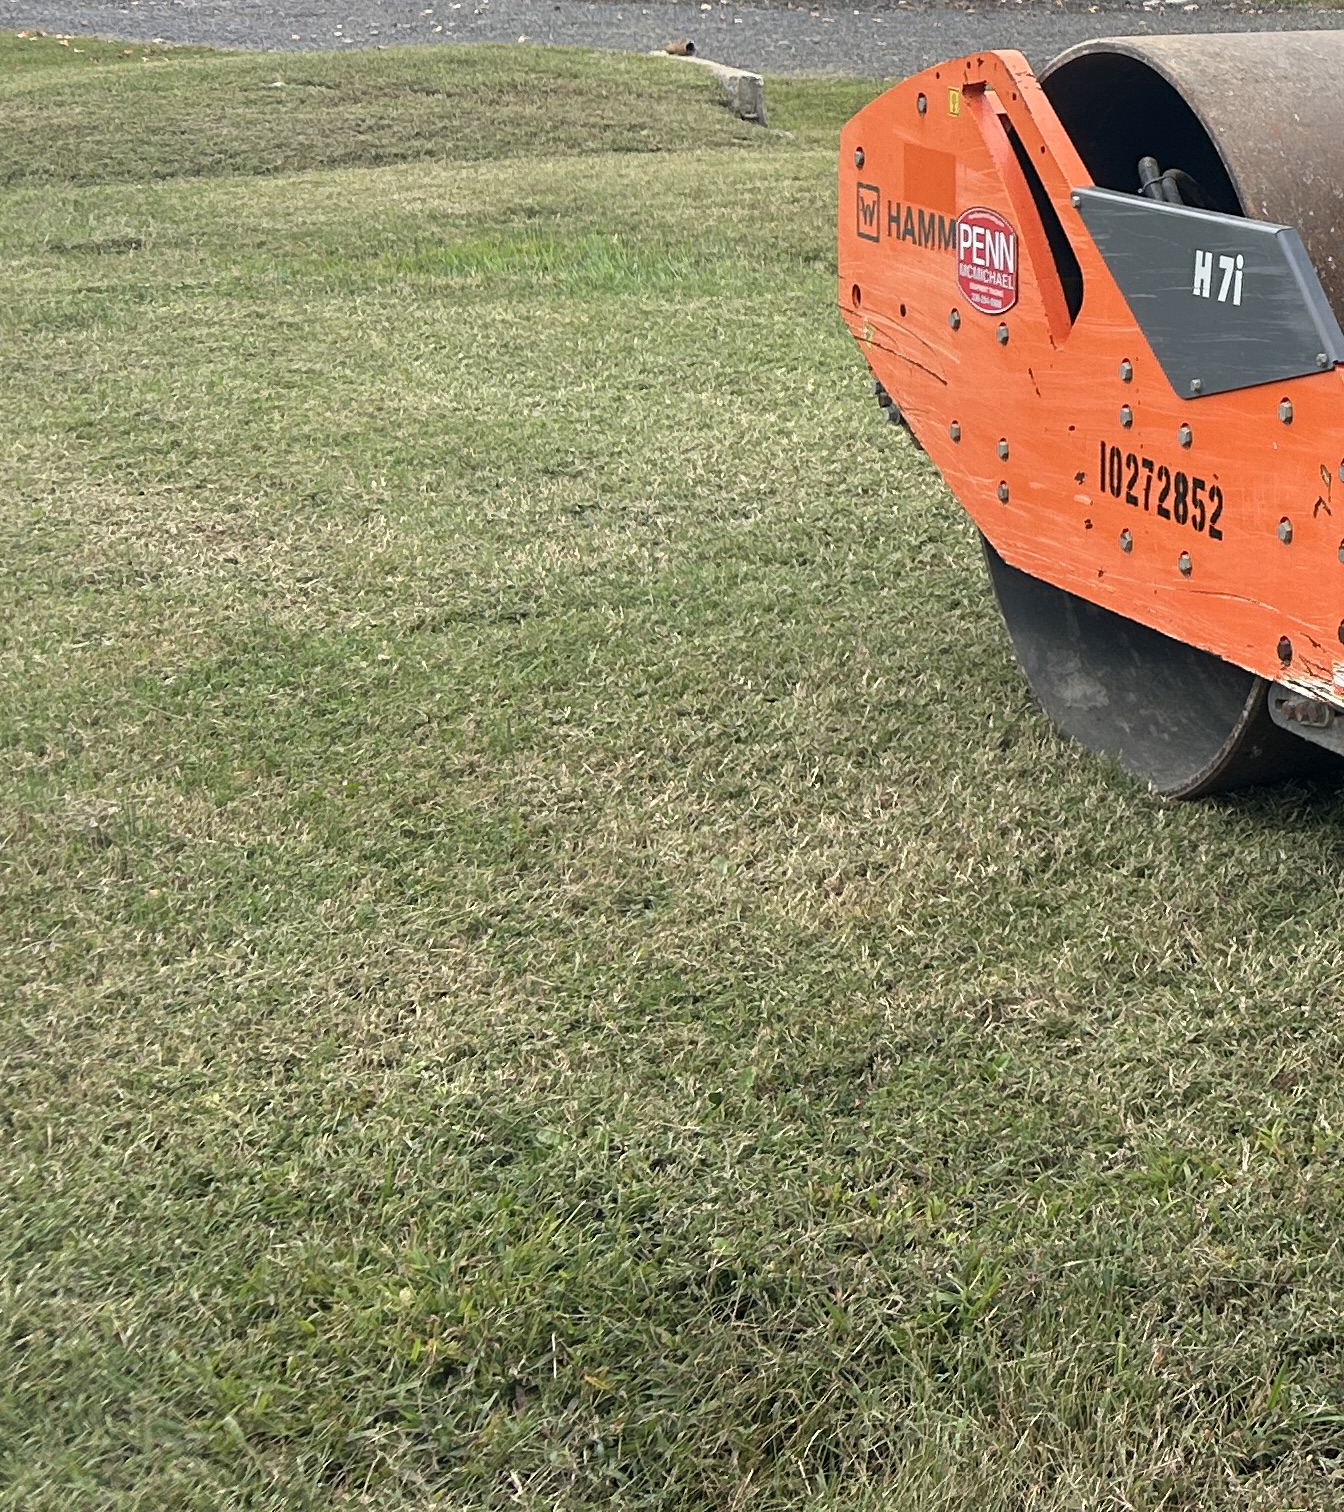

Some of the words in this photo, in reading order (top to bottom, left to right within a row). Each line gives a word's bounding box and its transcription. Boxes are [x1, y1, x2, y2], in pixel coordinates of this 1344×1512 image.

[887, 199, 957, 252] HAMM
[959, 222, 1014, 275] PENN
[1192, 249, 1213, 299] H
